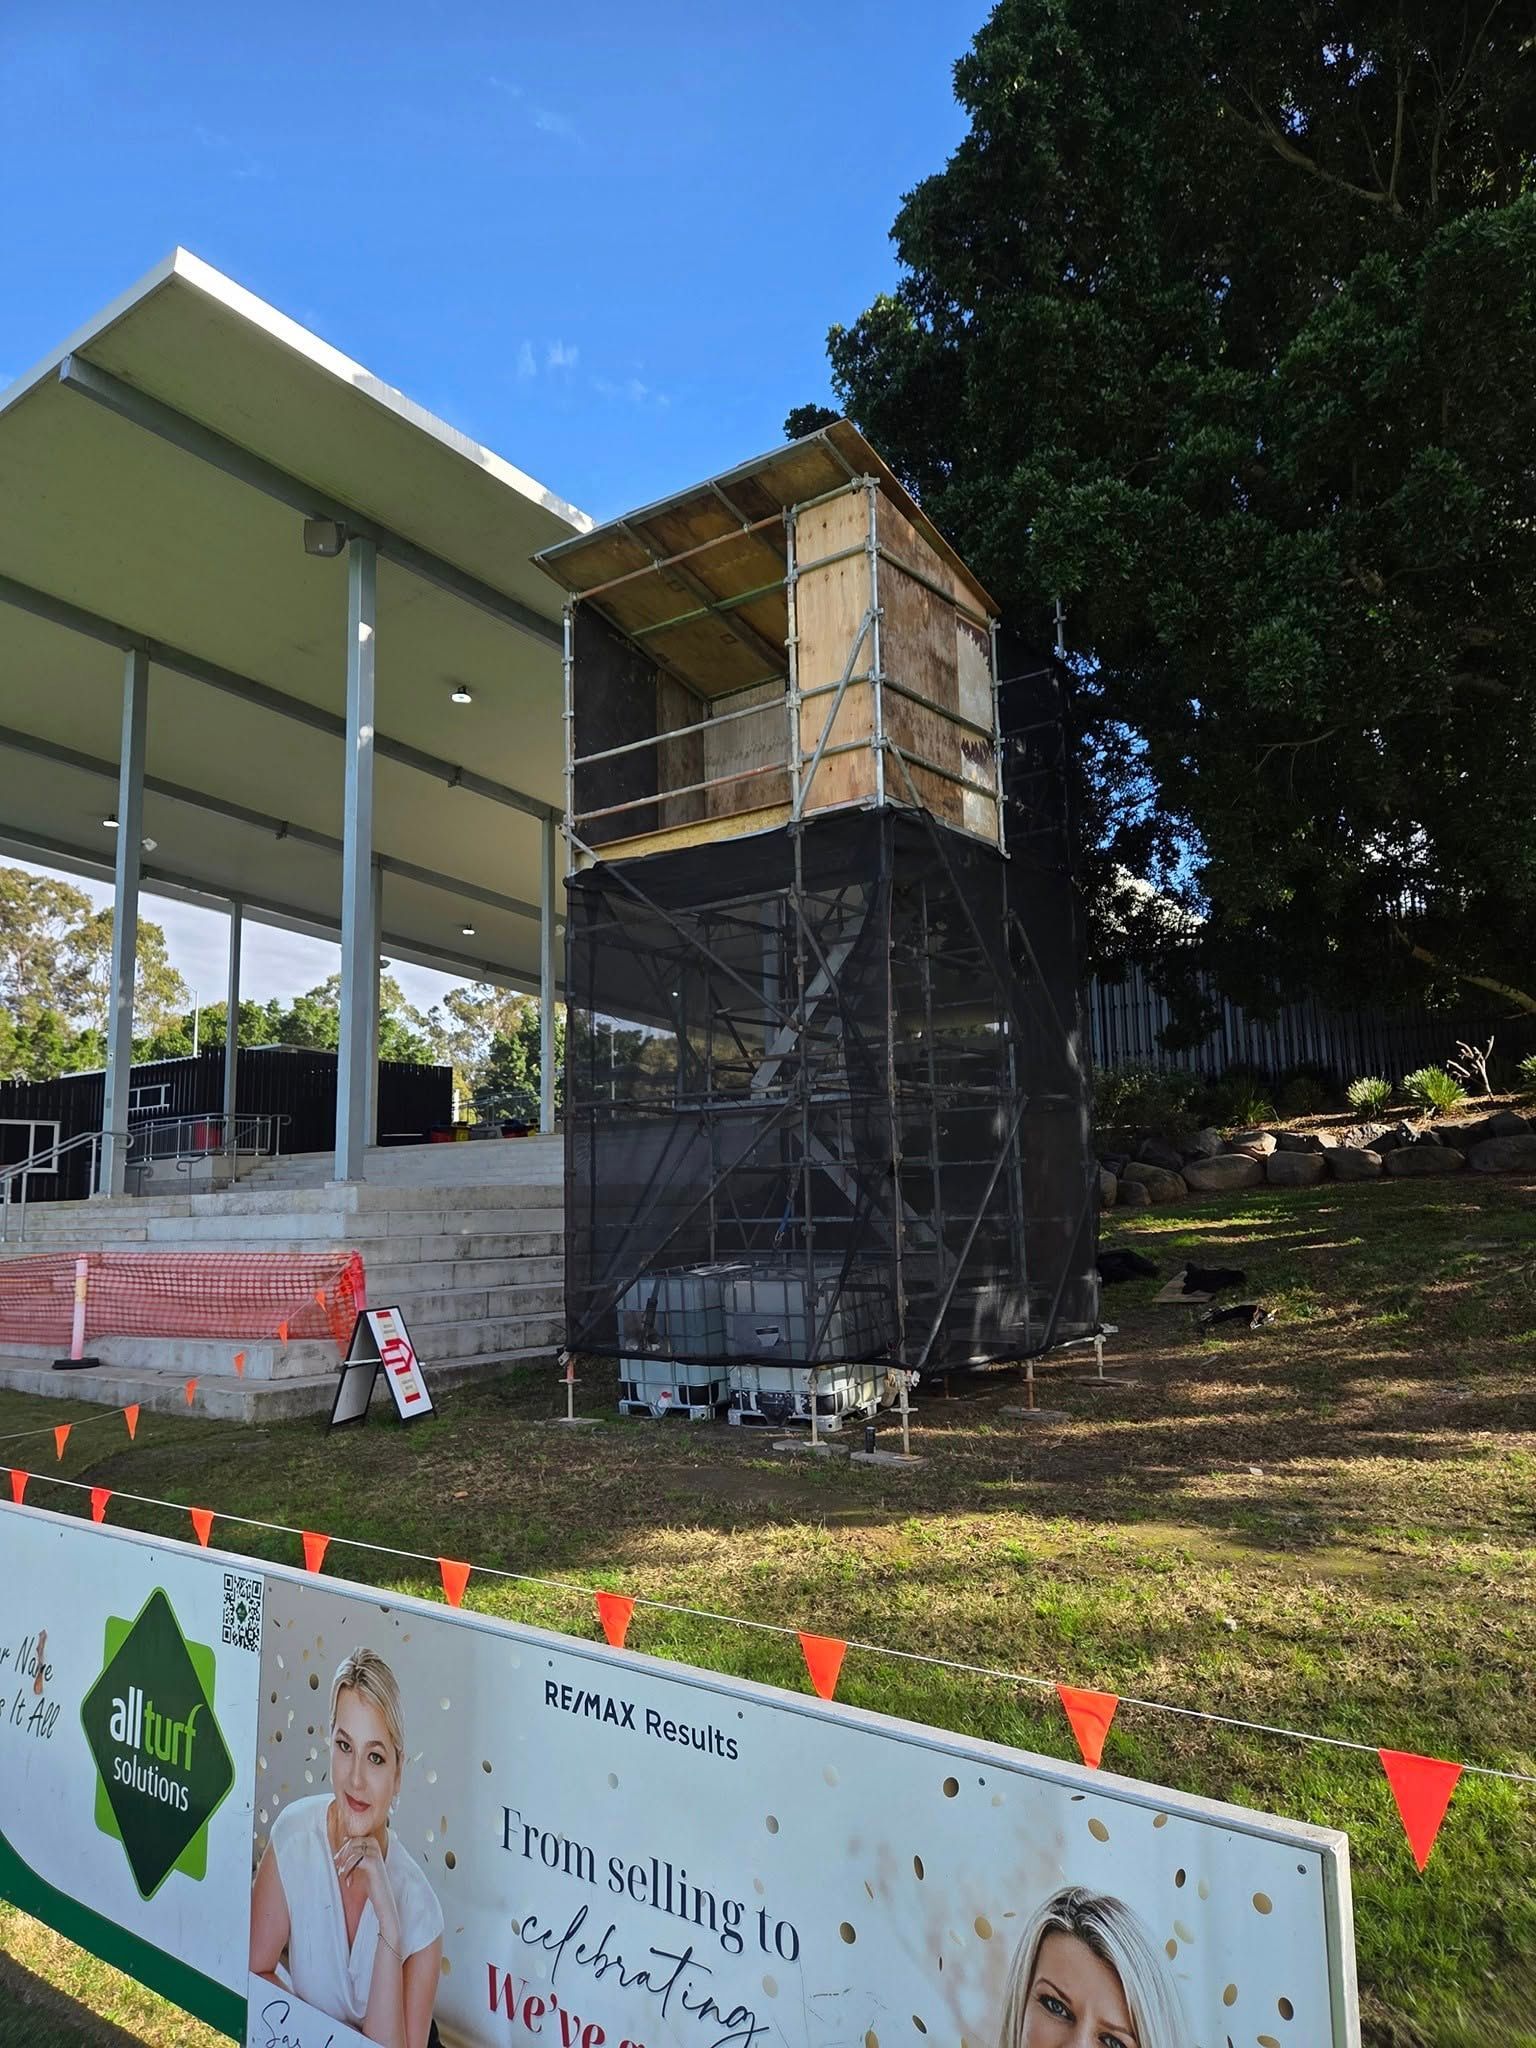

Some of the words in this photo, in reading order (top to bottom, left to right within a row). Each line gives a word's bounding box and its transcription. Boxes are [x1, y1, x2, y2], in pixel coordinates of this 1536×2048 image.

[9, 1688, 26, 1726] It
[26, 1697, 61, 1739] All
[544, 1680, 636, 1731] RE/MAX
[645, 1708, 740, 1760] Results
[113, 1754, 190, 1812] solutions
[500, 1805, 598, 1884] From
[608, 1854, 745, 1954] selling
[757, 1904, 801, 1962] to
[485, 1962, 607, 2048] We've
[519, 1904, 770, 2048] celebrating
